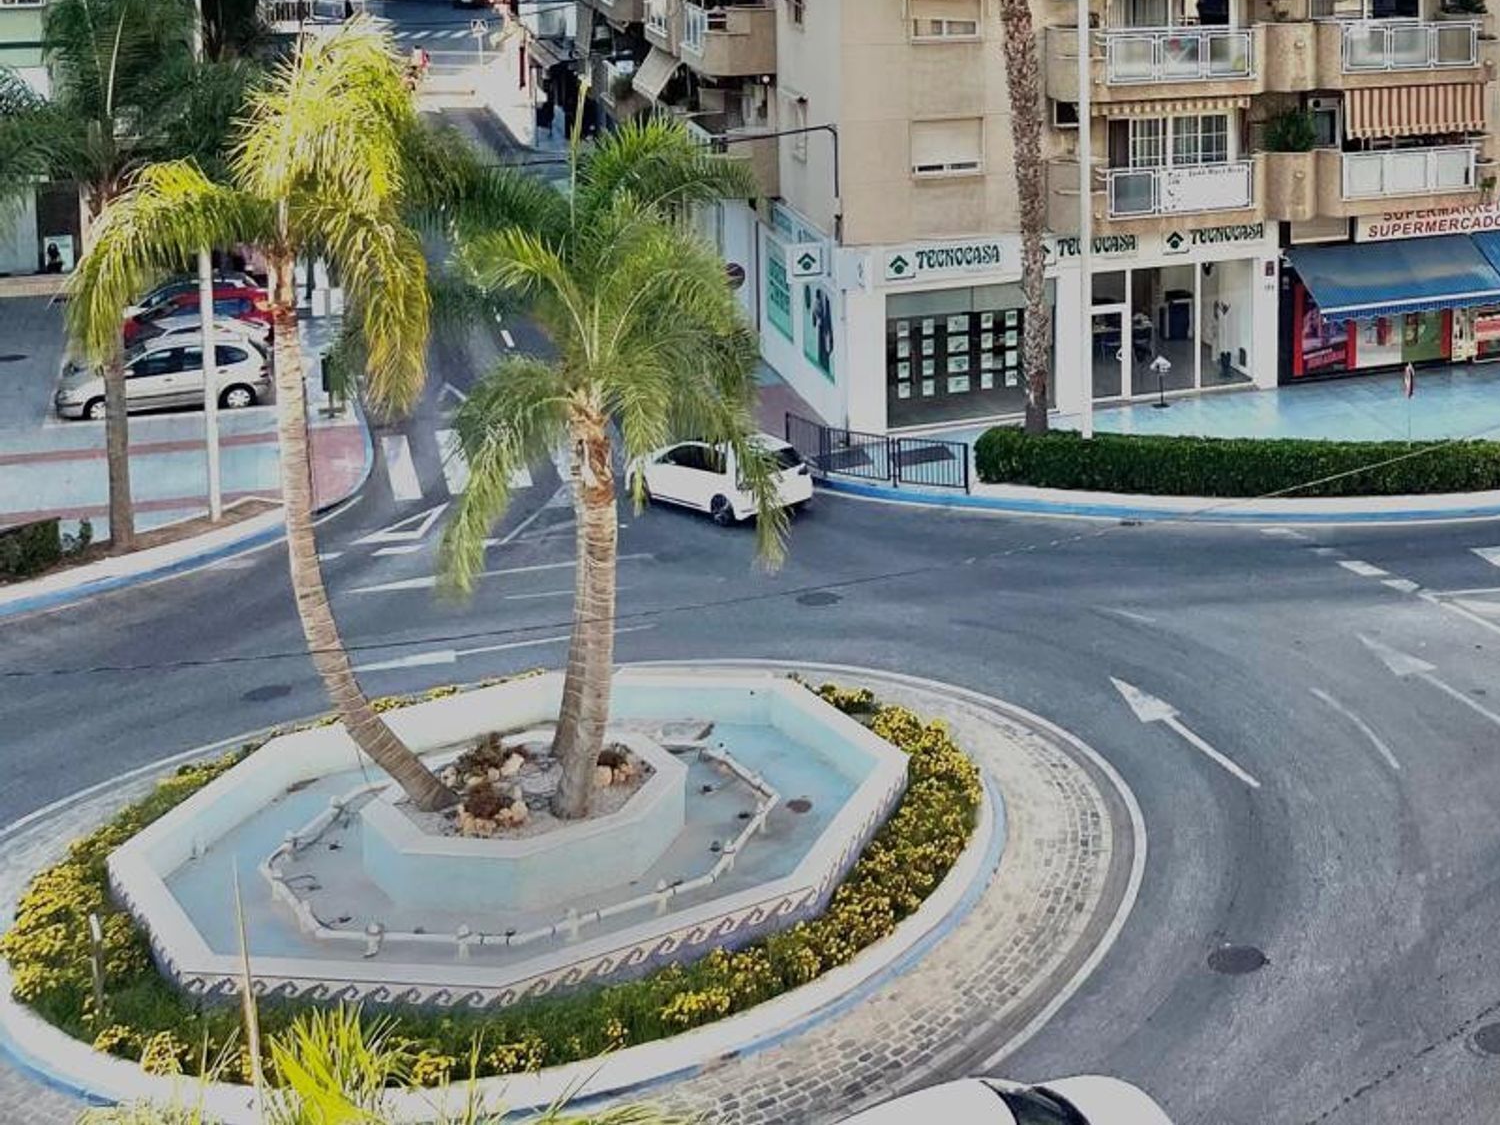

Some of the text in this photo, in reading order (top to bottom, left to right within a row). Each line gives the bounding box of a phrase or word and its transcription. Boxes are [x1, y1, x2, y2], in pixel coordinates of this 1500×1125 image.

[1189, 223, 1264, 245] TECNOCASA
[915, 244, 1001, 270] TECNOCASA
[1057, 235, 1137, 257] TECOCASA
